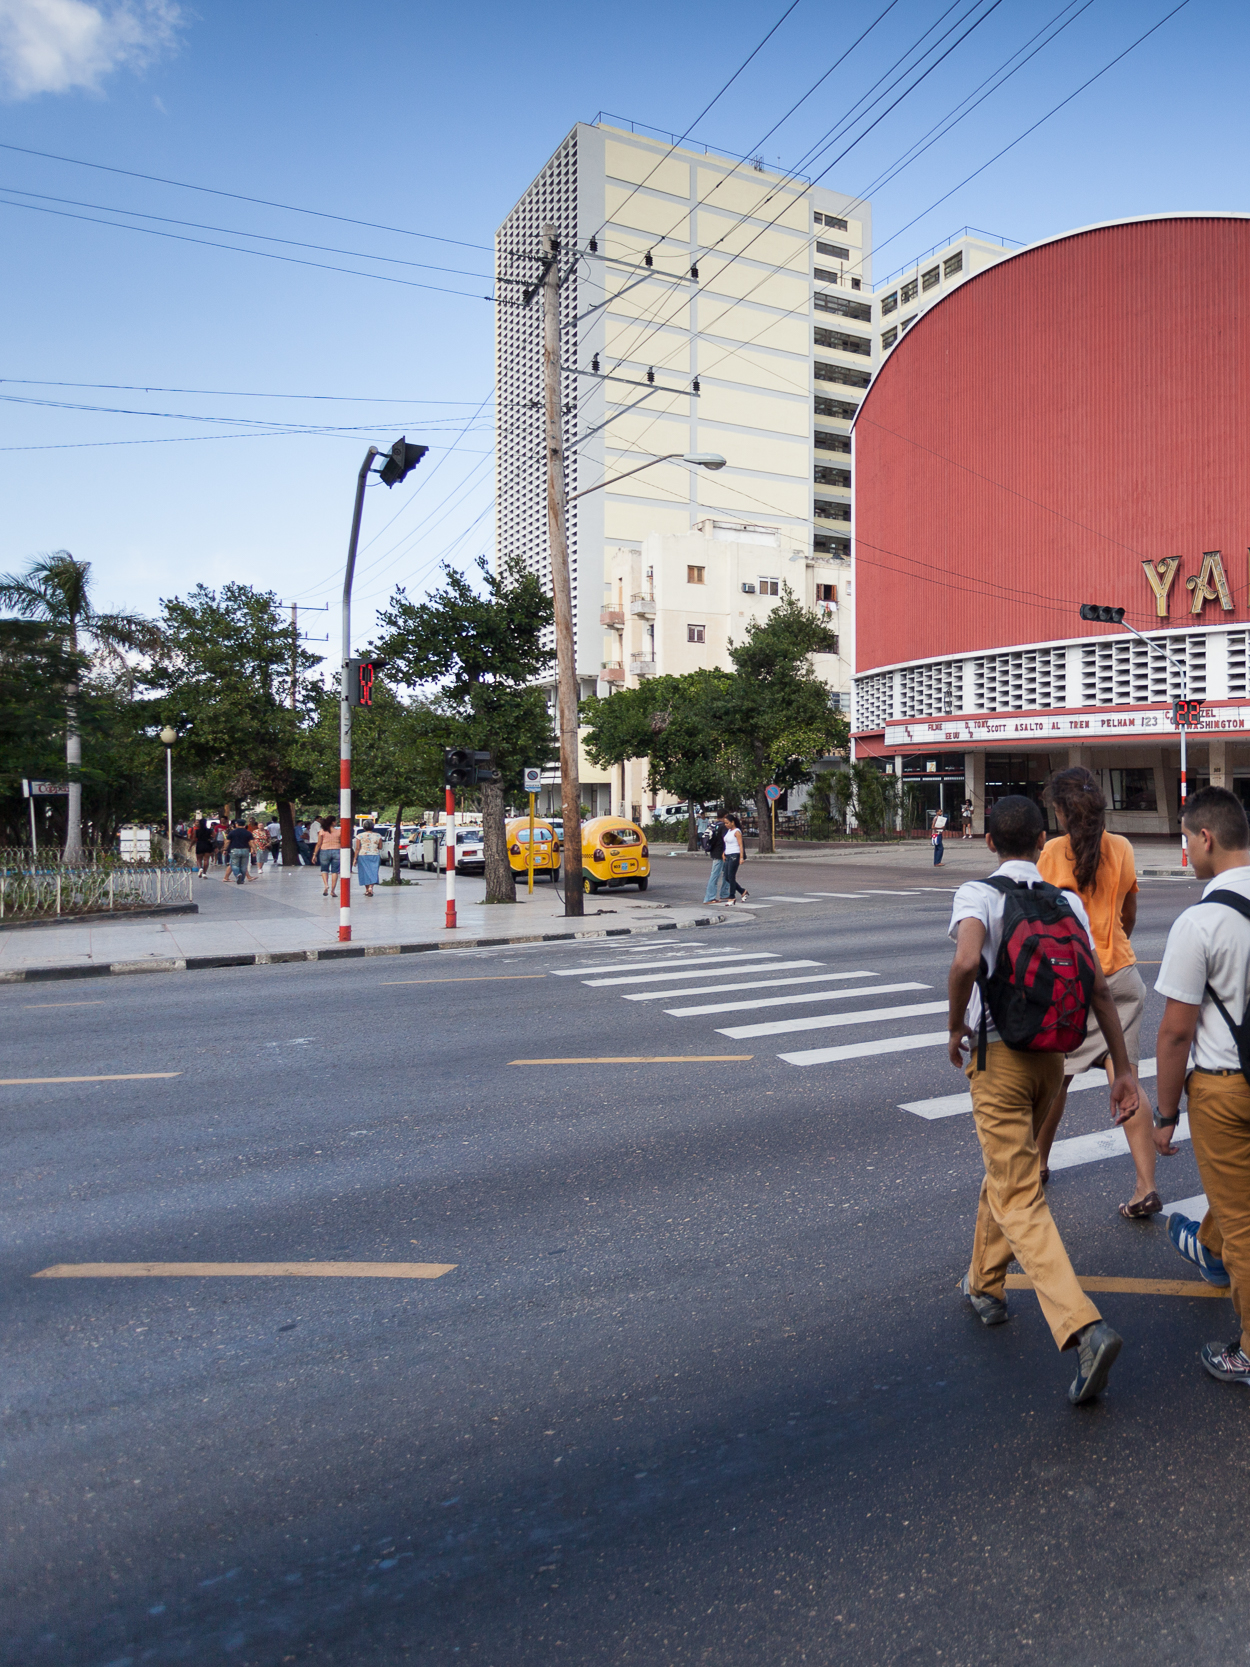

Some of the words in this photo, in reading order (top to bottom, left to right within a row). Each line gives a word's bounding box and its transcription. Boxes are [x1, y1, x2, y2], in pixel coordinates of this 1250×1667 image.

[1176, 702, 1199, 724] 22
[974, 720, 989, 729] TONY
[986, 724, 1007, 733] SCOTT
[1014, 722, 1044, 732] ASALTO
[1051, 721, 1061, 730] AL
[1069, 720, 1090, 729] TREN
[1101, 718, 1136, 728] PELHAM
[1141, 716, 1158, 727] 123
